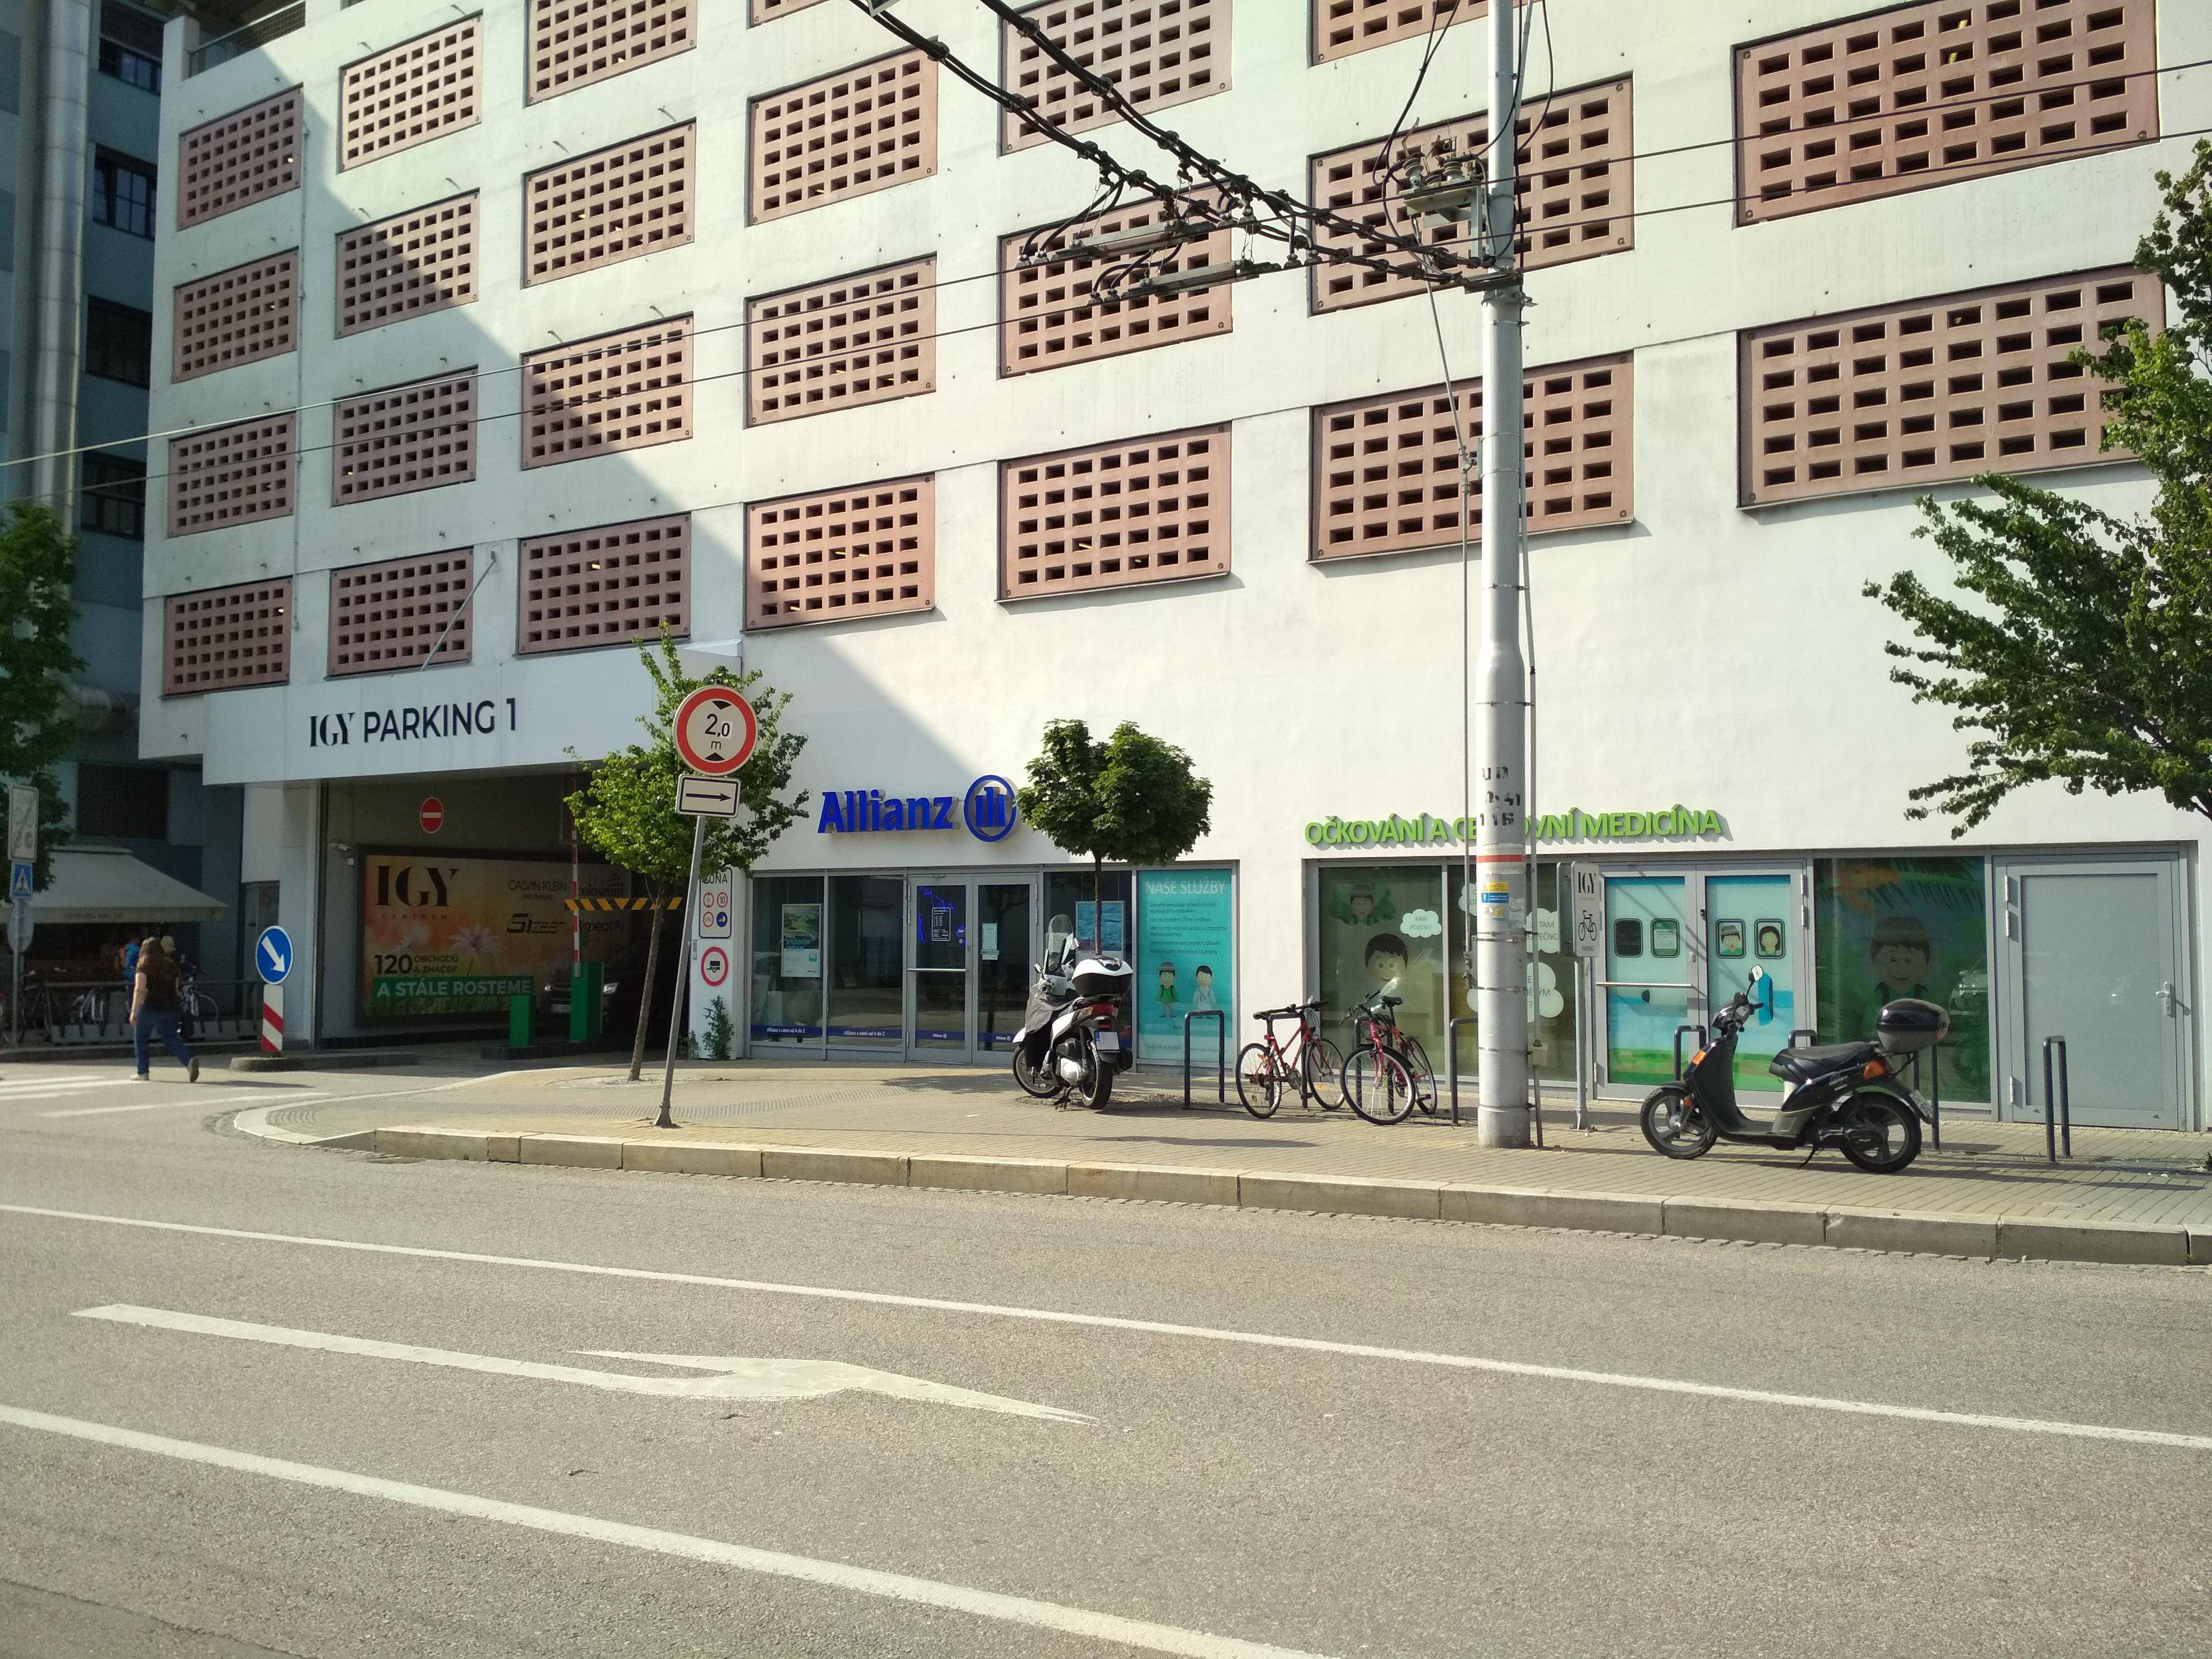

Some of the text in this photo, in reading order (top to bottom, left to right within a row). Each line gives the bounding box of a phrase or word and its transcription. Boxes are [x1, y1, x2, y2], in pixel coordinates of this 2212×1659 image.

[309, 698, 516, 748] IGY PARKING 1
[705, 713, 730, 737] 2,0
[711, 740, 722, 749] m
[817, 789, 953, 833] Allianz
[1305, 804, 1721, 844] OČKOVÁNÍ A CEVNÍ MEDICÍNA
[375, 865, 460, 907] IGY
[508, 879, 567, 891] CALVIN KLEIN
[1146, 877, 1225, 894] NAŠE SLUŽBY
[1578, 872, 1597, 894] IGY
[719, 896, 726, 904] 10
[374, 953, 459, 974] 120 OBCHODŮ
[377, 978, 532, 997] A STÁLE ROSTEME
